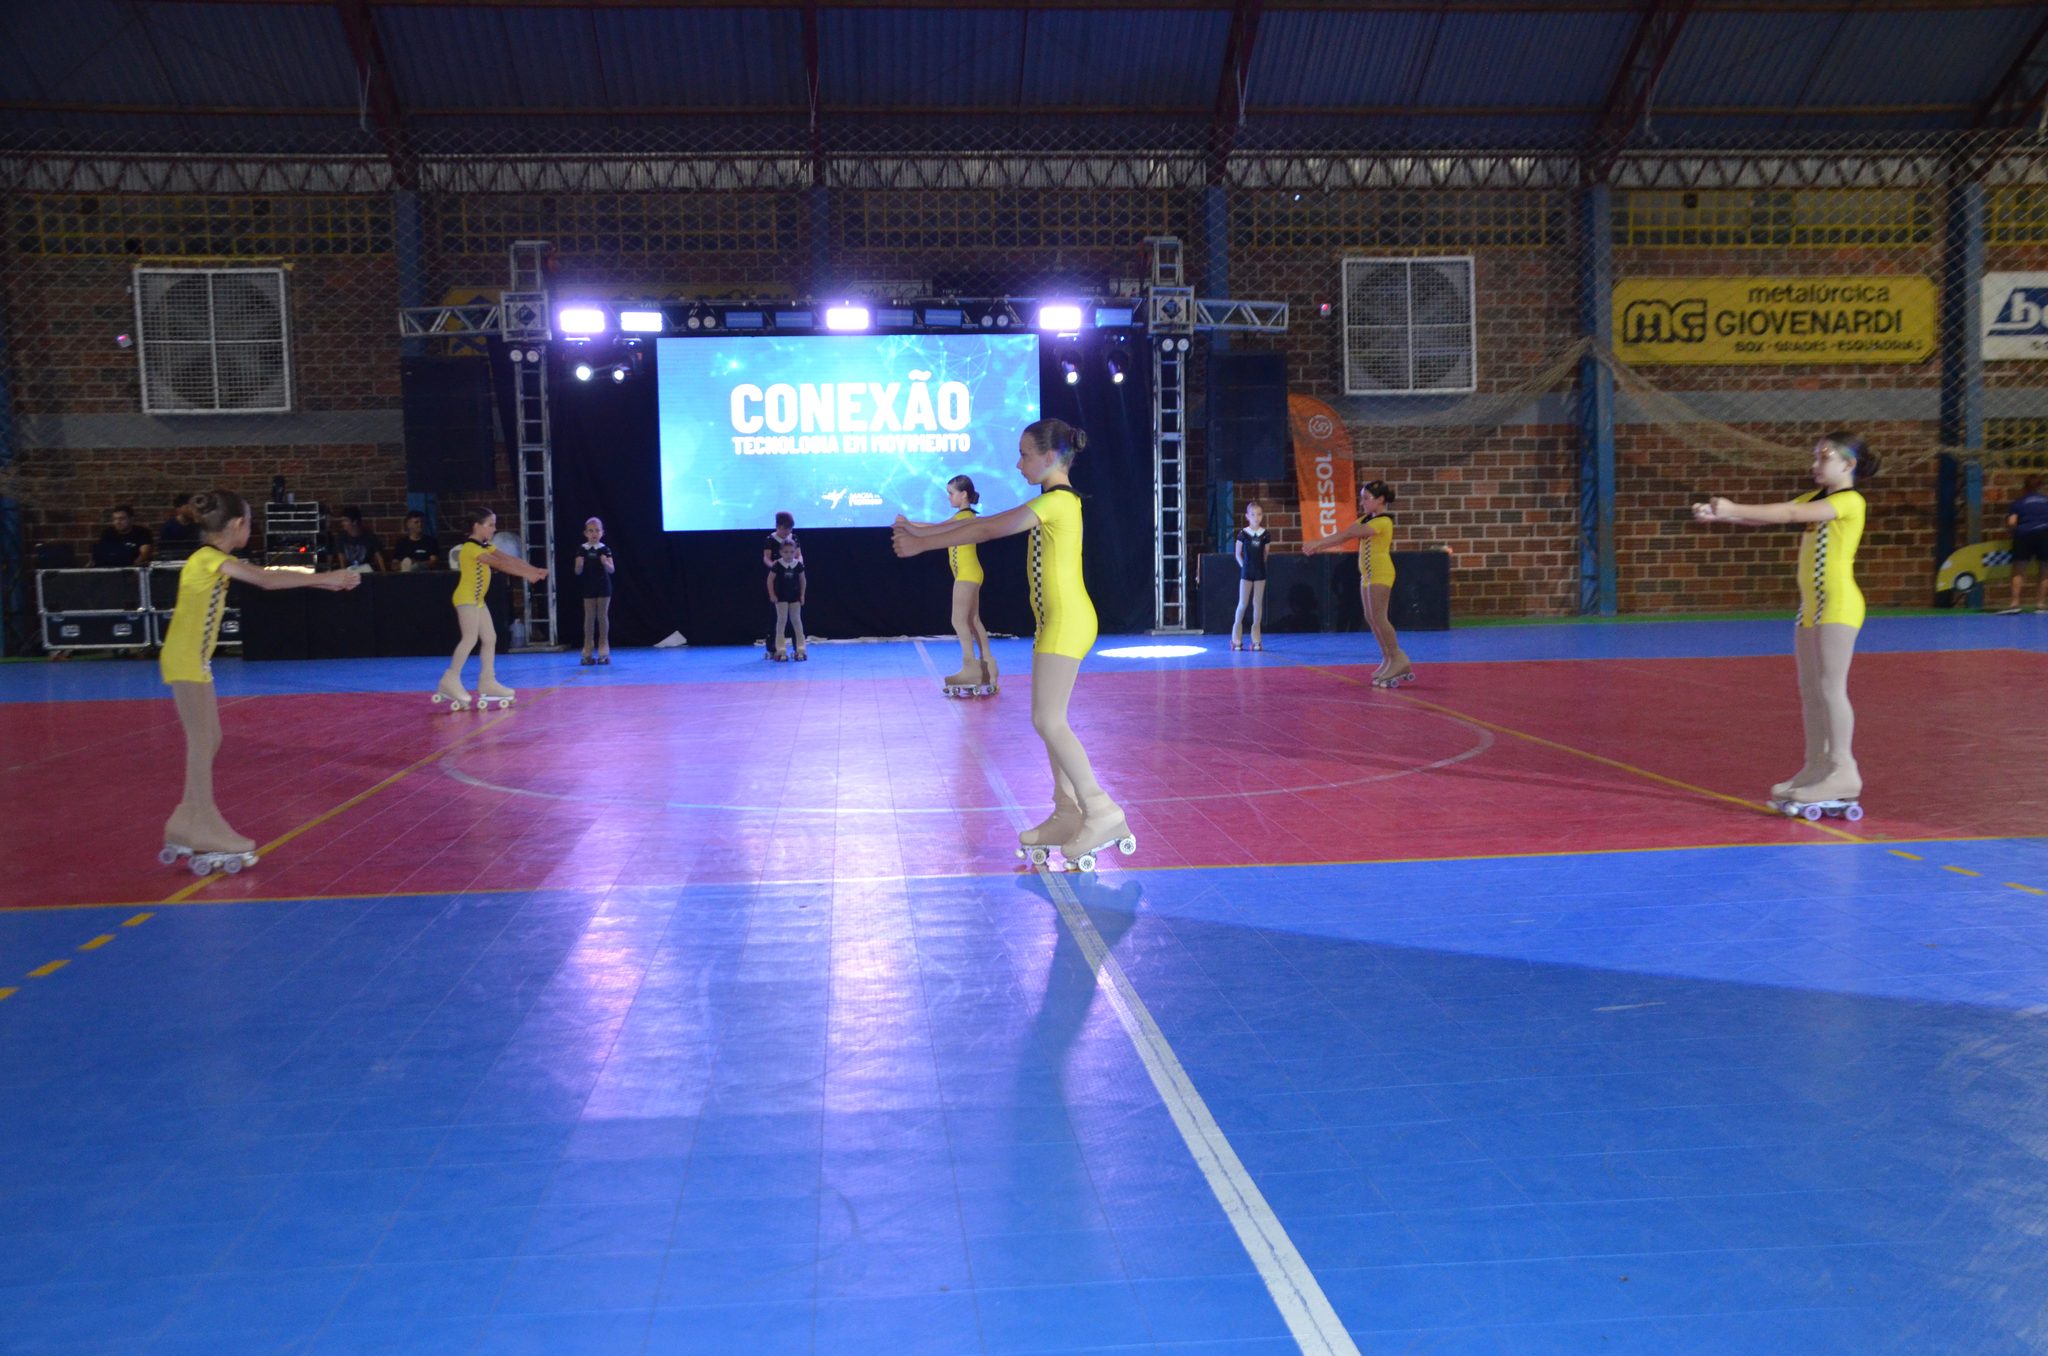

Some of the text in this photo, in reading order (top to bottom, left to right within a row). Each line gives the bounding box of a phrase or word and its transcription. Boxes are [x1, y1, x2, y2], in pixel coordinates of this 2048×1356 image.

[1714, 308, 1903, 338] GIOVENARDI
[730, 369, 970, 434] CONEXÃO
[732, 434, 970, 455] TECNOLOGIA EM MOVIMENTO
[1315, 451, 1337, 538] CRESOL
